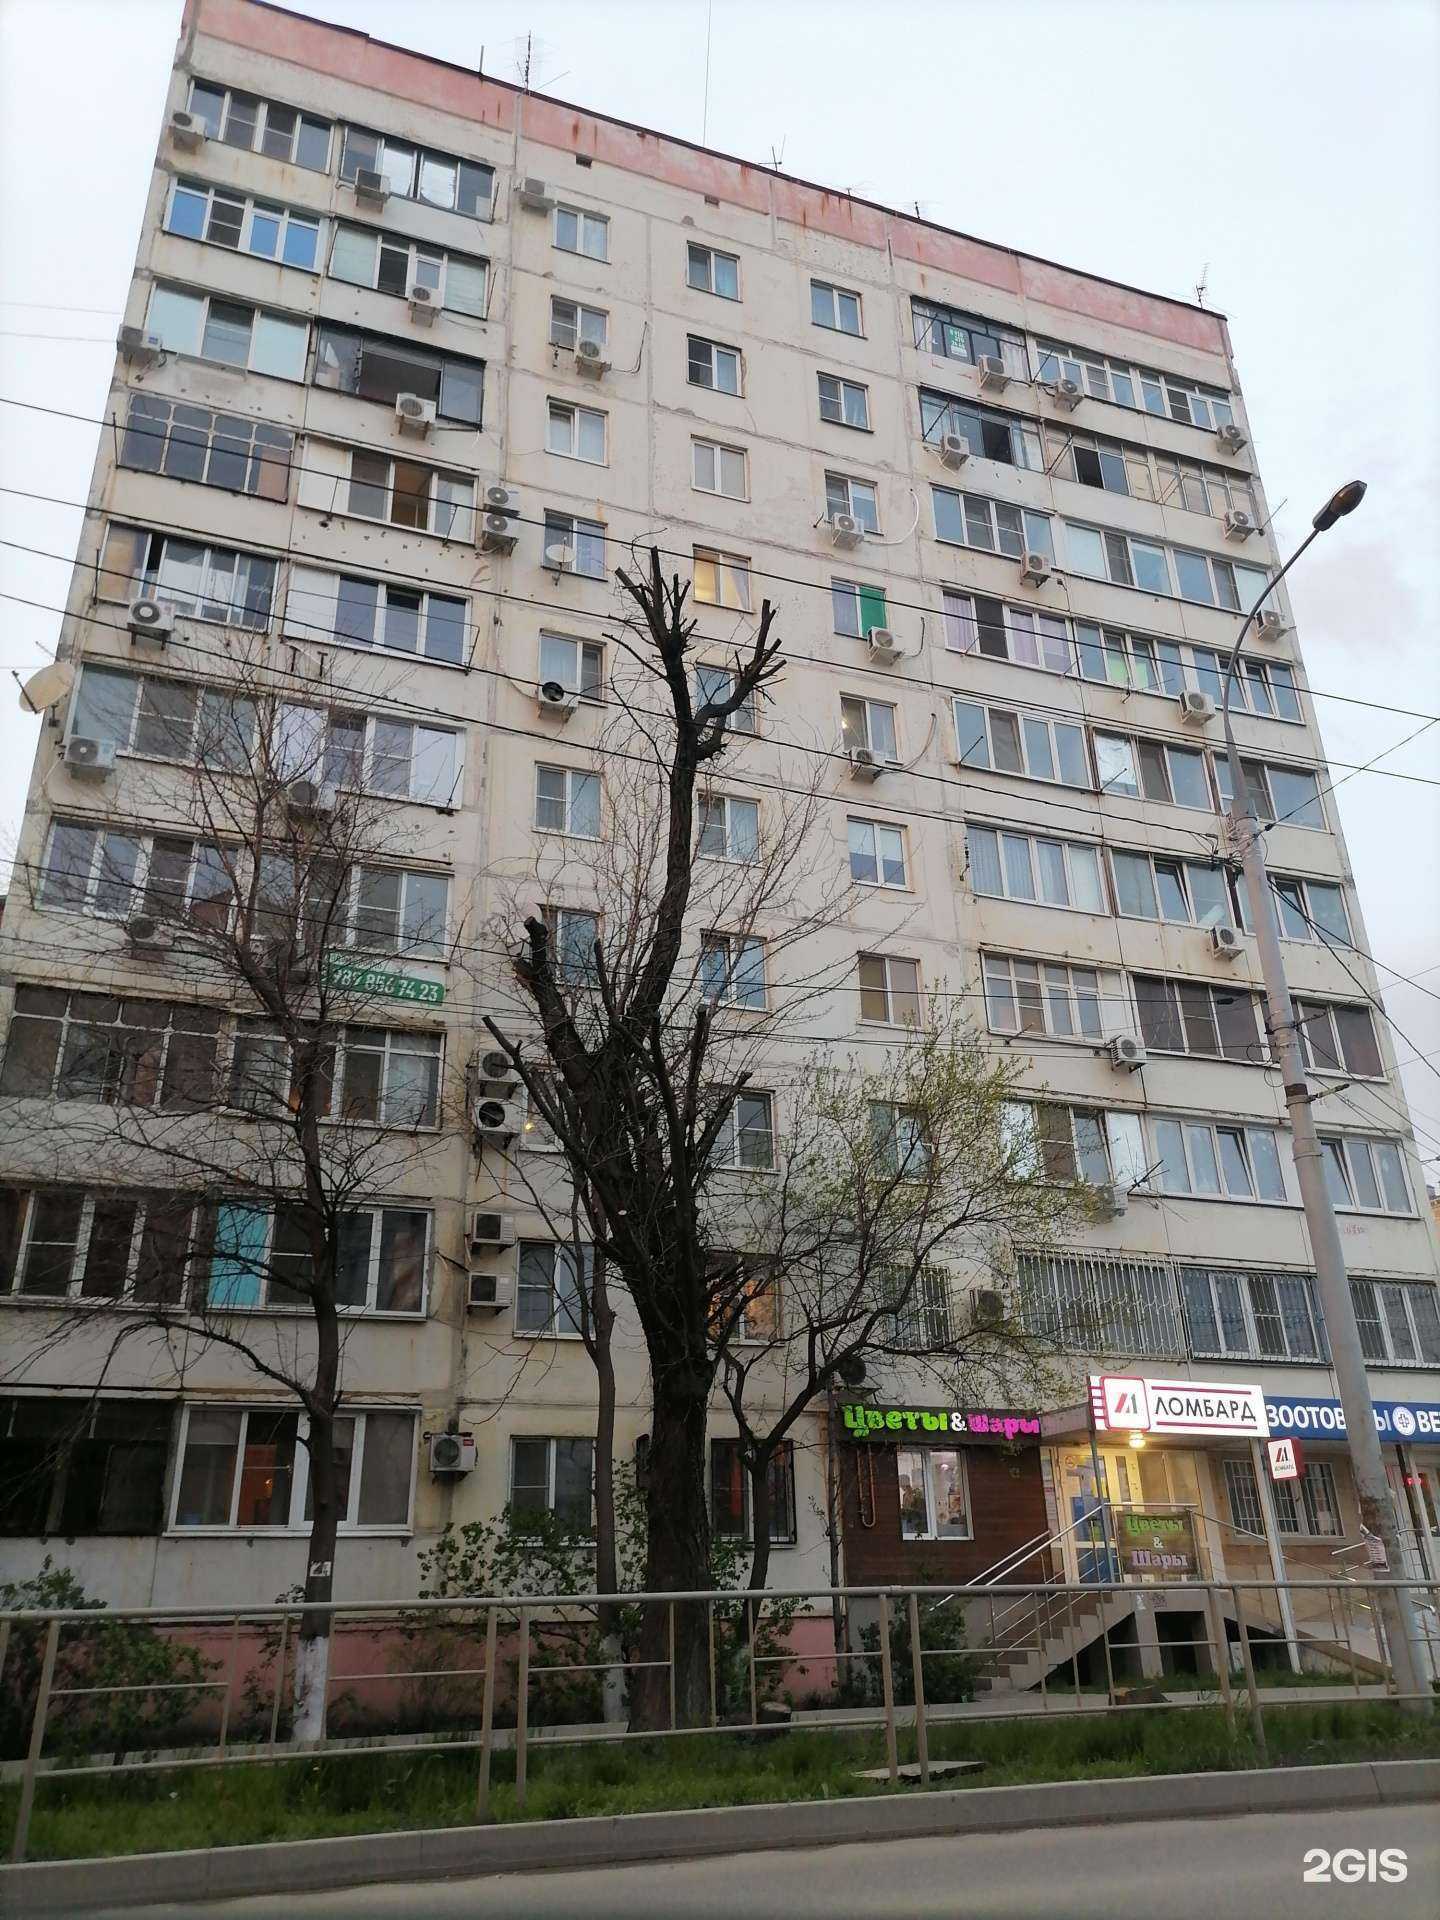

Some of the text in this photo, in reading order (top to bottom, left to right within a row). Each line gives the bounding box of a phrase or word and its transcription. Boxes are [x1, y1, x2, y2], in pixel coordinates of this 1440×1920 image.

[418, 983, 438, 1002] 23
[1155, 1396, 1256, 1422] ЛОМБАРД
[1266, 1404, 1392, 1431] ЗООТОВЫ
[842, 1405, 948, 1438] Цветы
[951, 1412, 967, 1432] &
[1126, 1516, 1184, 1536] Цветы
[1153, 1536, 1164, 1549] &
[1131, 1550, 1188, 1569] Шары
